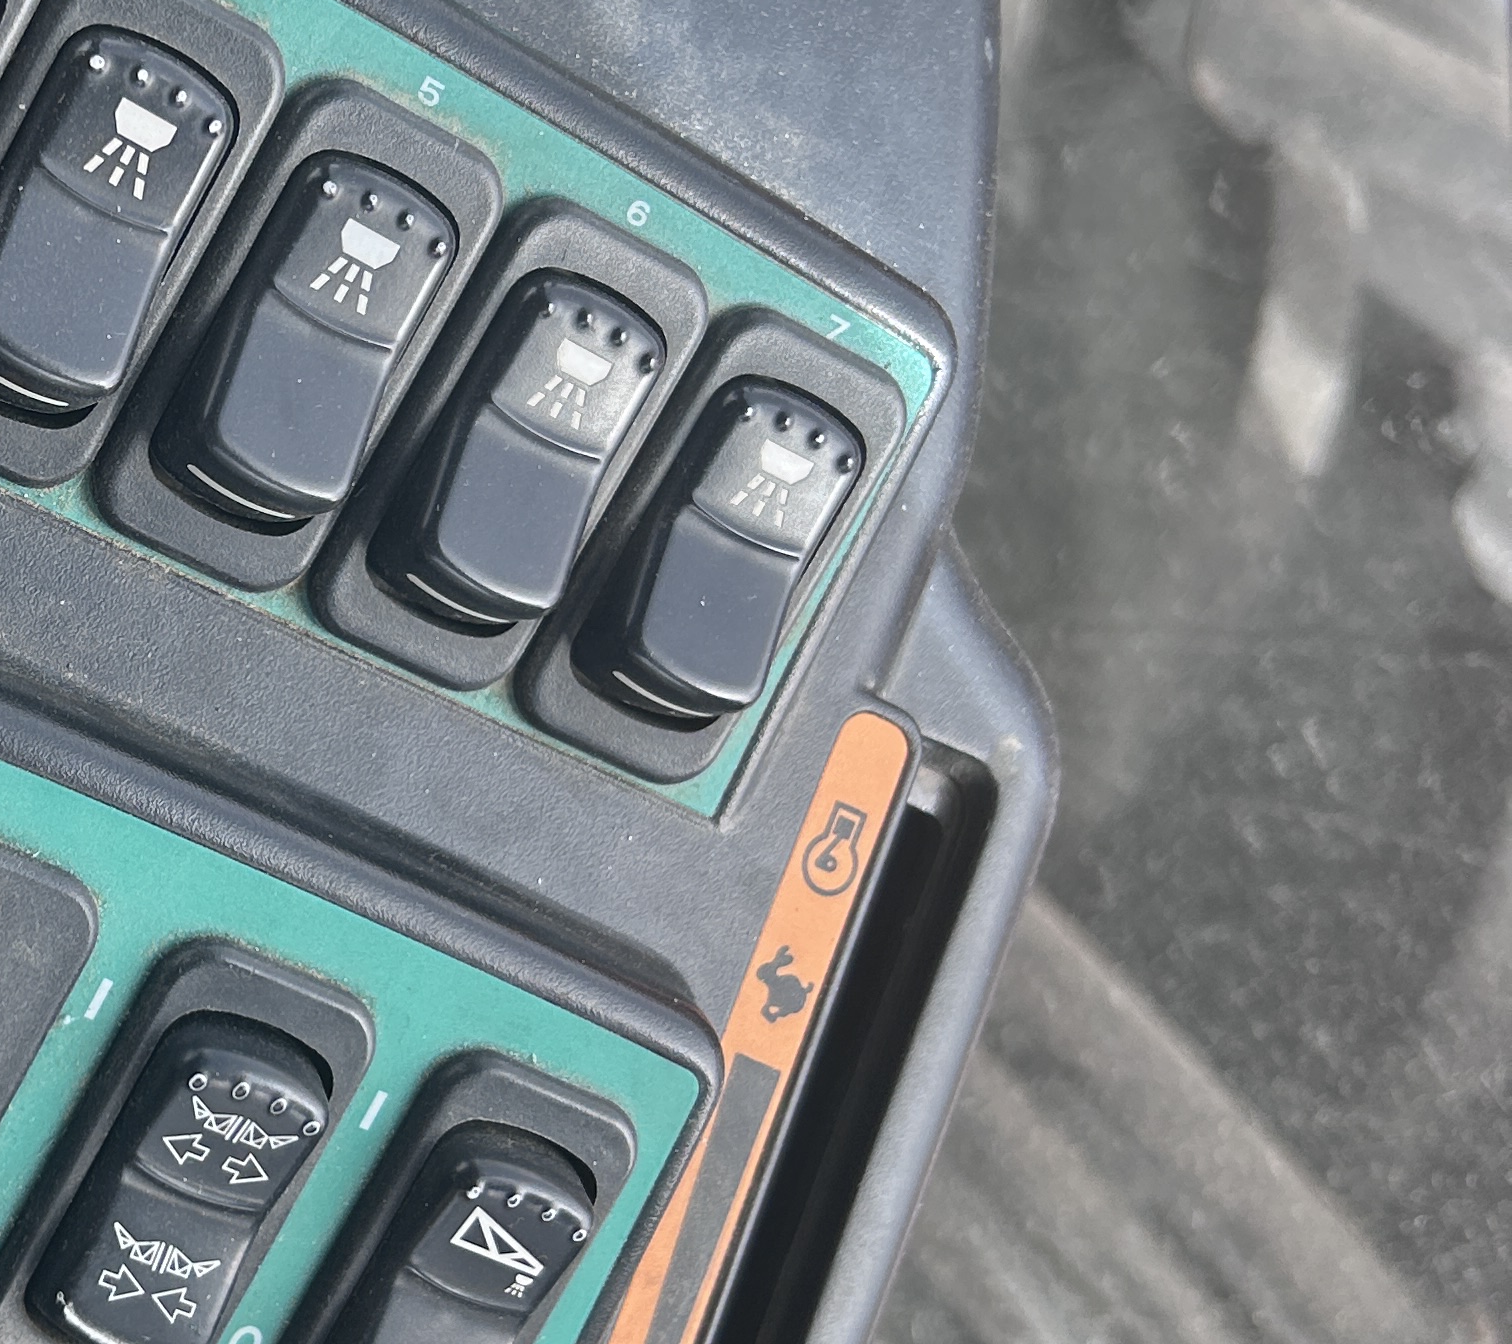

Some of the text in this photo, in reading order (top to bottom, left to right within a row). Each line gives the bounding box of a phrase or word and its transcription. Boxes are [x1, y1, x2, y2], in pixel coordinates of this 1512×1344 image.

[418, 76, 445, 106] 5
[626, 199, 650, 227] 6
[828, 315, 852, 341] 7
